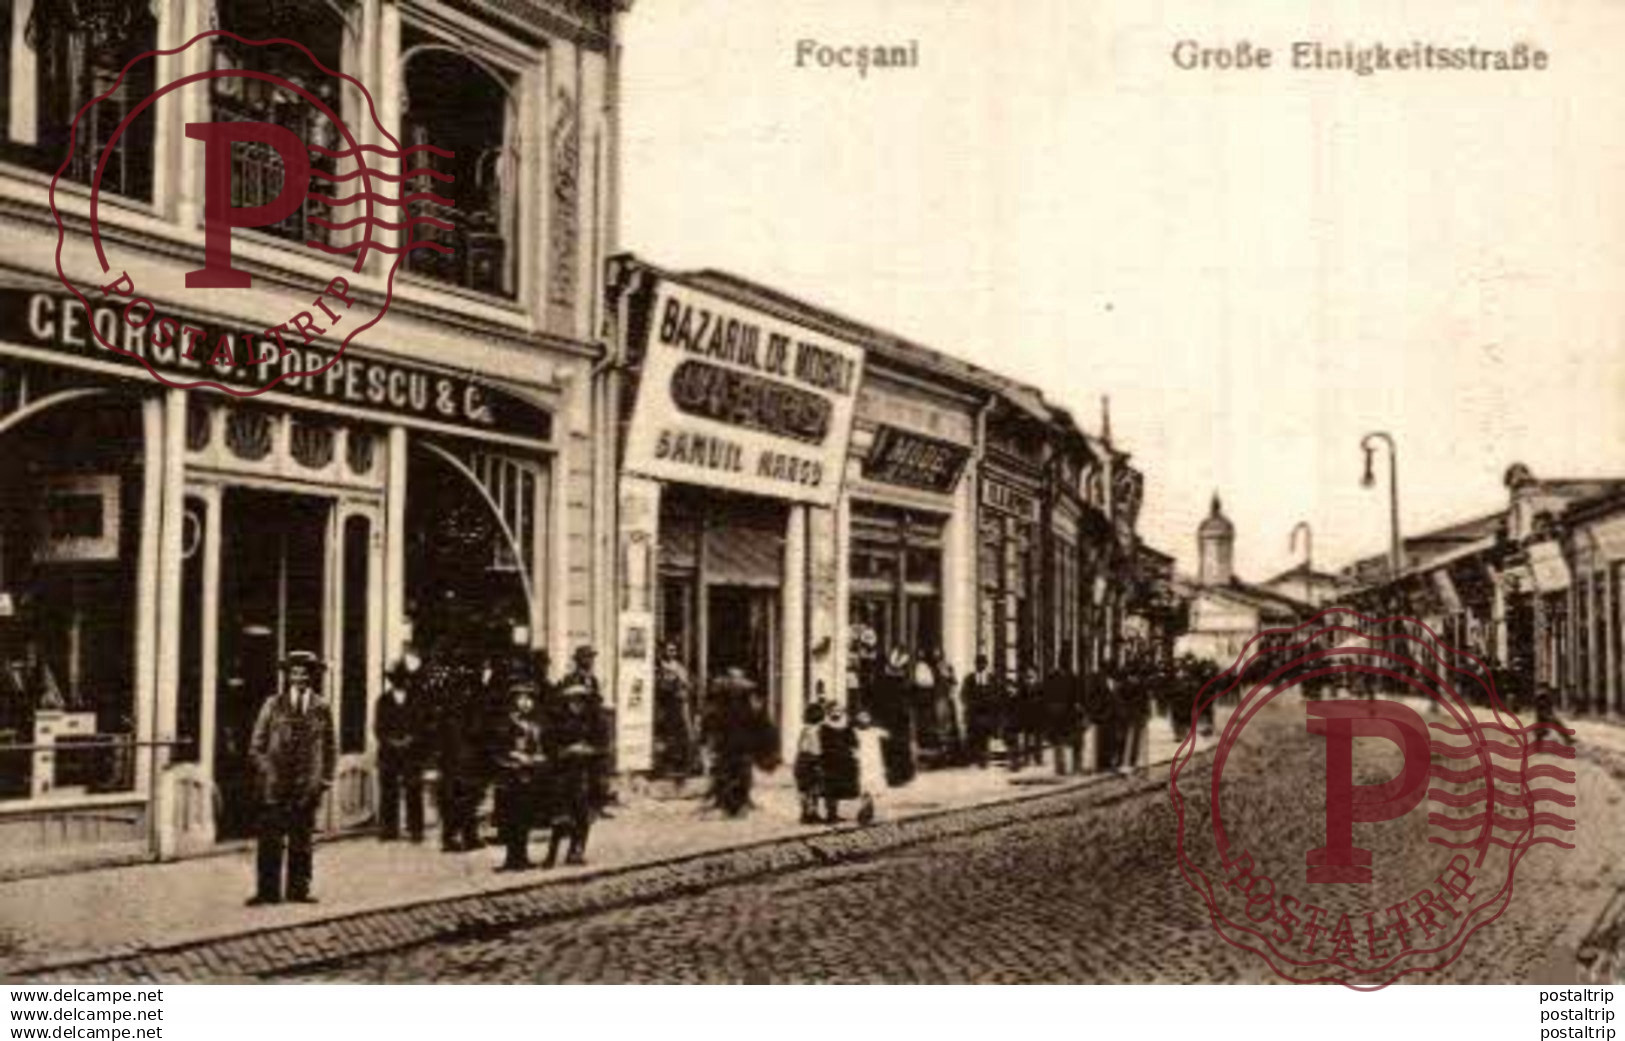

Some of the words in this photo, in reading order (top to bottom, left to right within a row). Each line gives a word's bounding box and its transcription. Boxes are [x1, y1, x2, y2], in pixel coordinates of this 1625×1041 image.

[659, 297, 762, 371] BAZARUL
[766, 333, 791, 377] DE
[258, 342, 427, 410] POPPESCU
[435, 380, 455, 415] &
